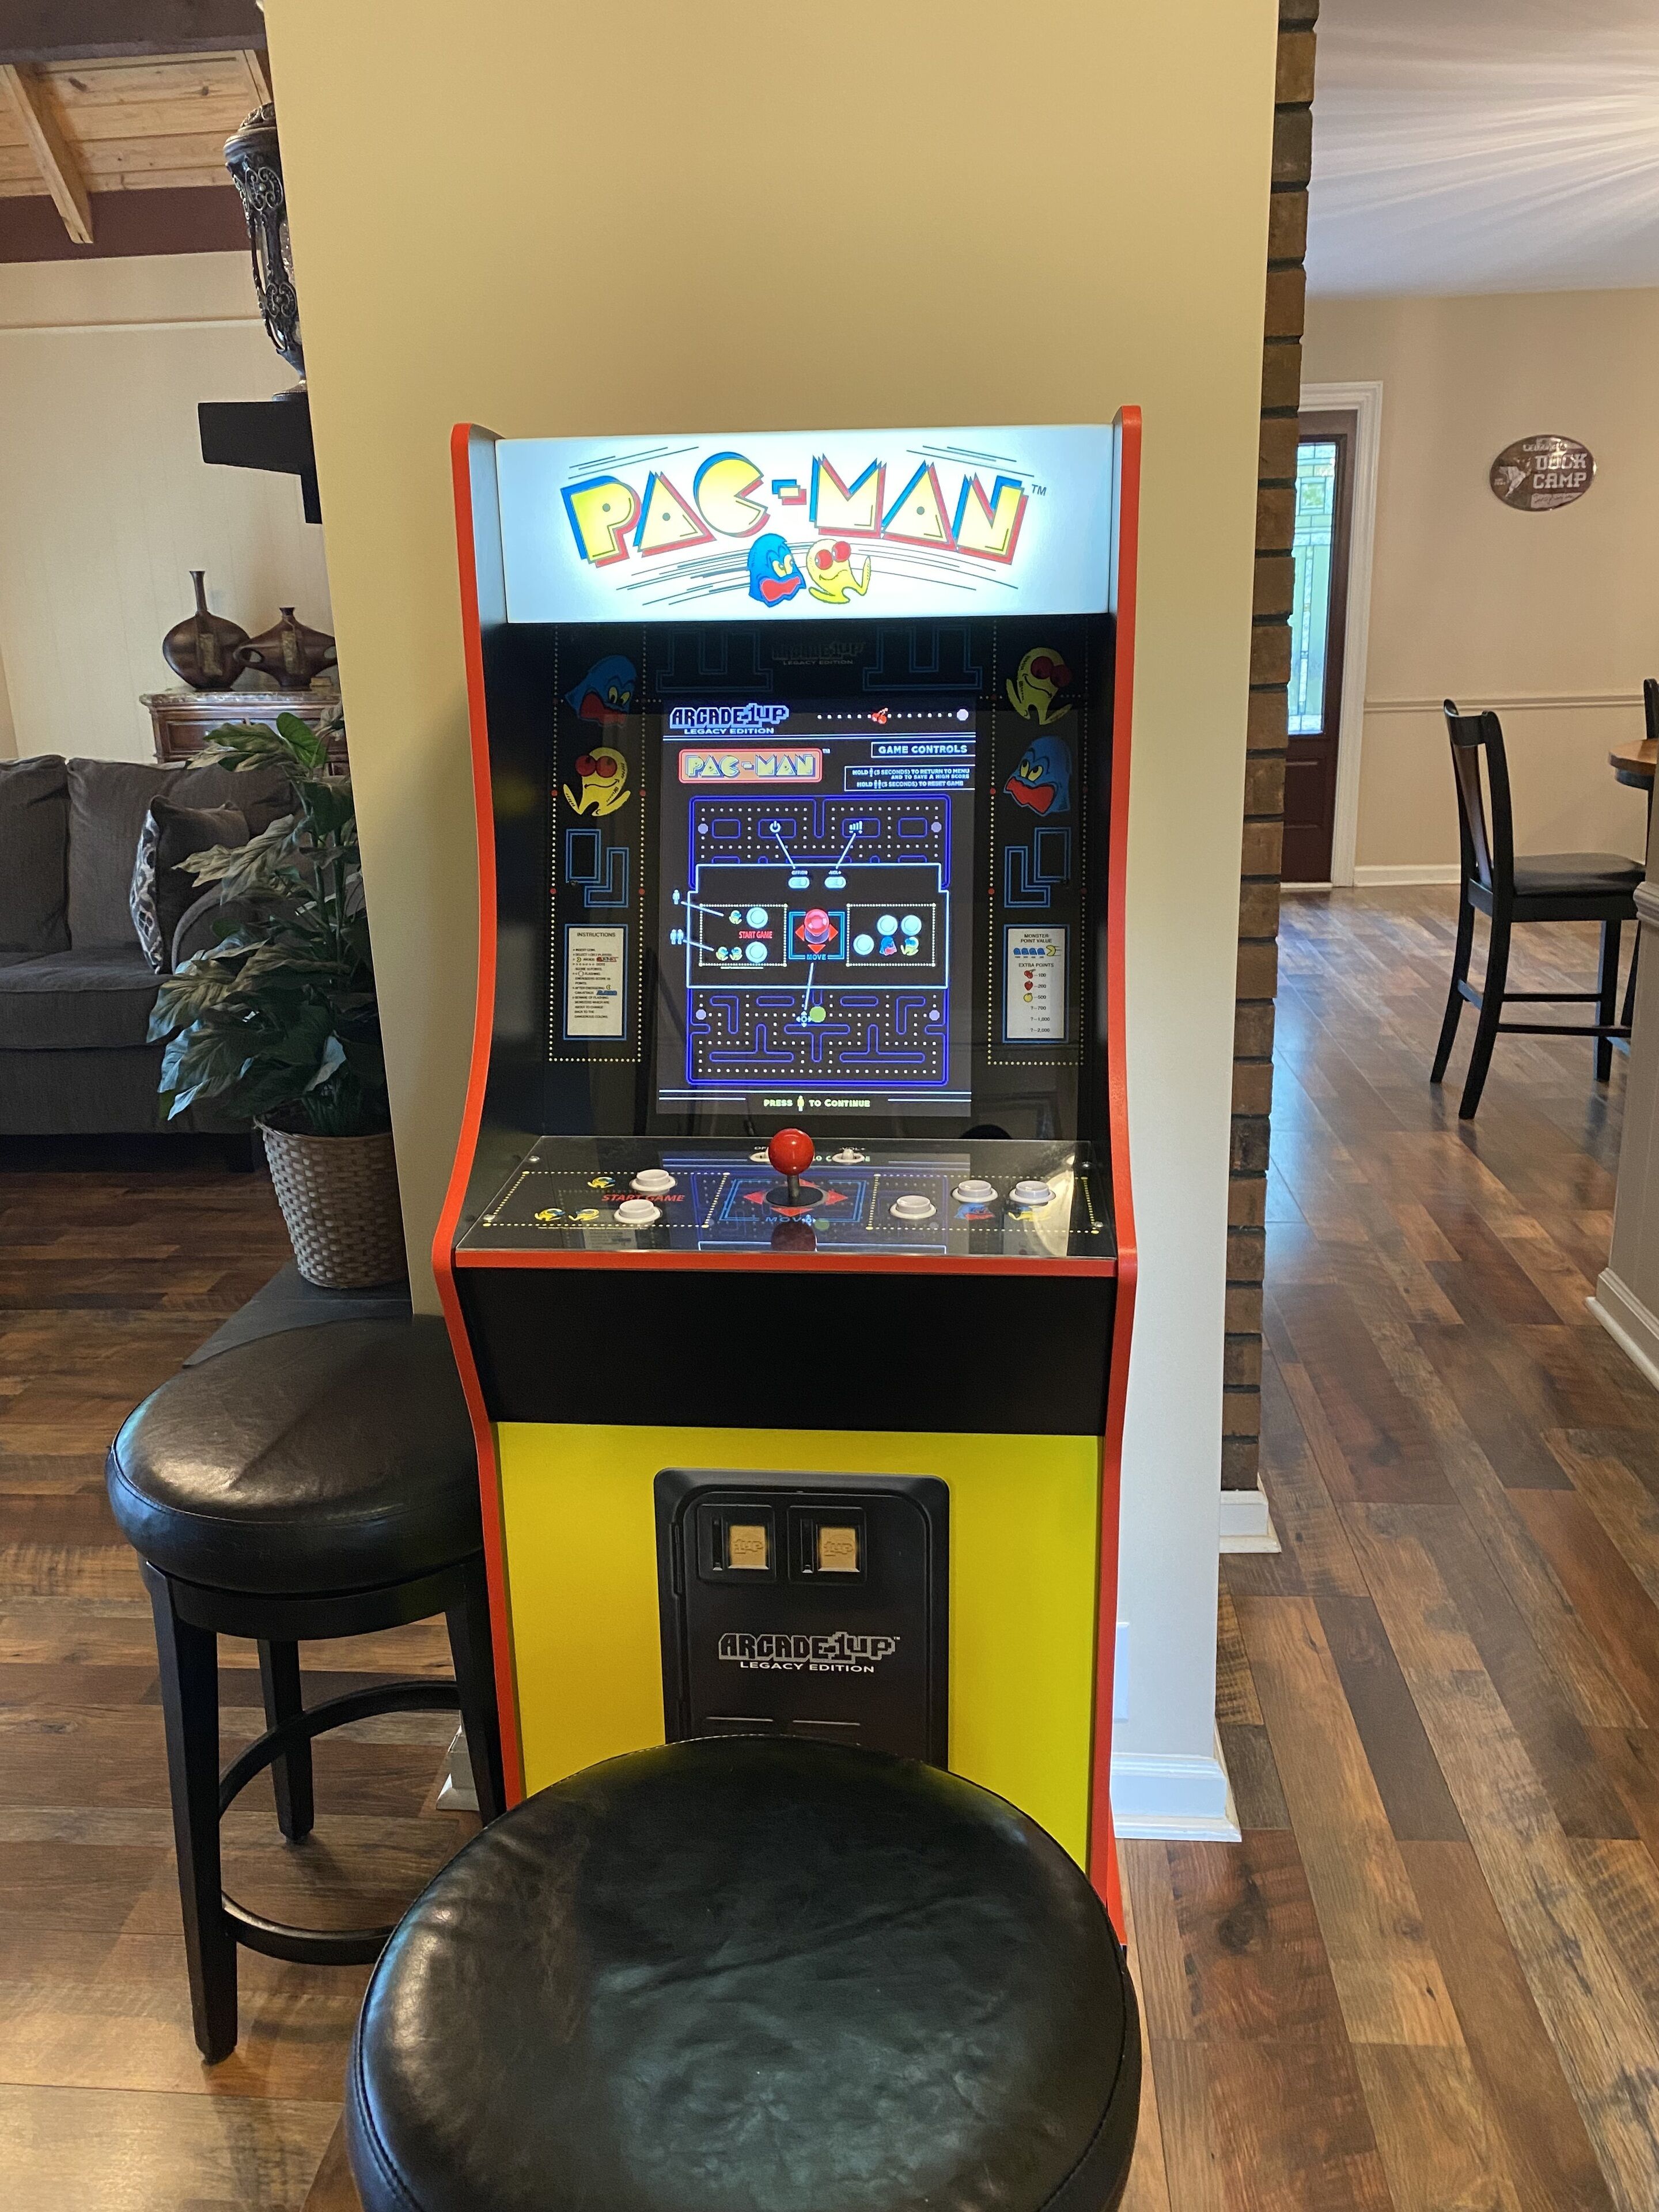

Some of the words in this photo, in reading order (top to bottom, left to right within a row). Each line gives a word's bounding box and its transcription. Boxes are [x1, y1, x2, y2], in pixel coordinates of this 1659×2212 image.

[1533, 472, 1587, 489] CAMP
[560, 452, 1029, 568] PAC-MAN
[878, 745, 908, 754] GAME
[911, 745, 968, 753] CONTROLS
[685, 754, 816, 778] PAC-MAN
[738, 930, 756, 939] START
[756, 930, 773, 939] GAME
[824, 1099, 871, 1107] CONTINUE
[740, 1661, 804, 1670] LEGACY
[809, 1664, 874, 1673] EDITION
